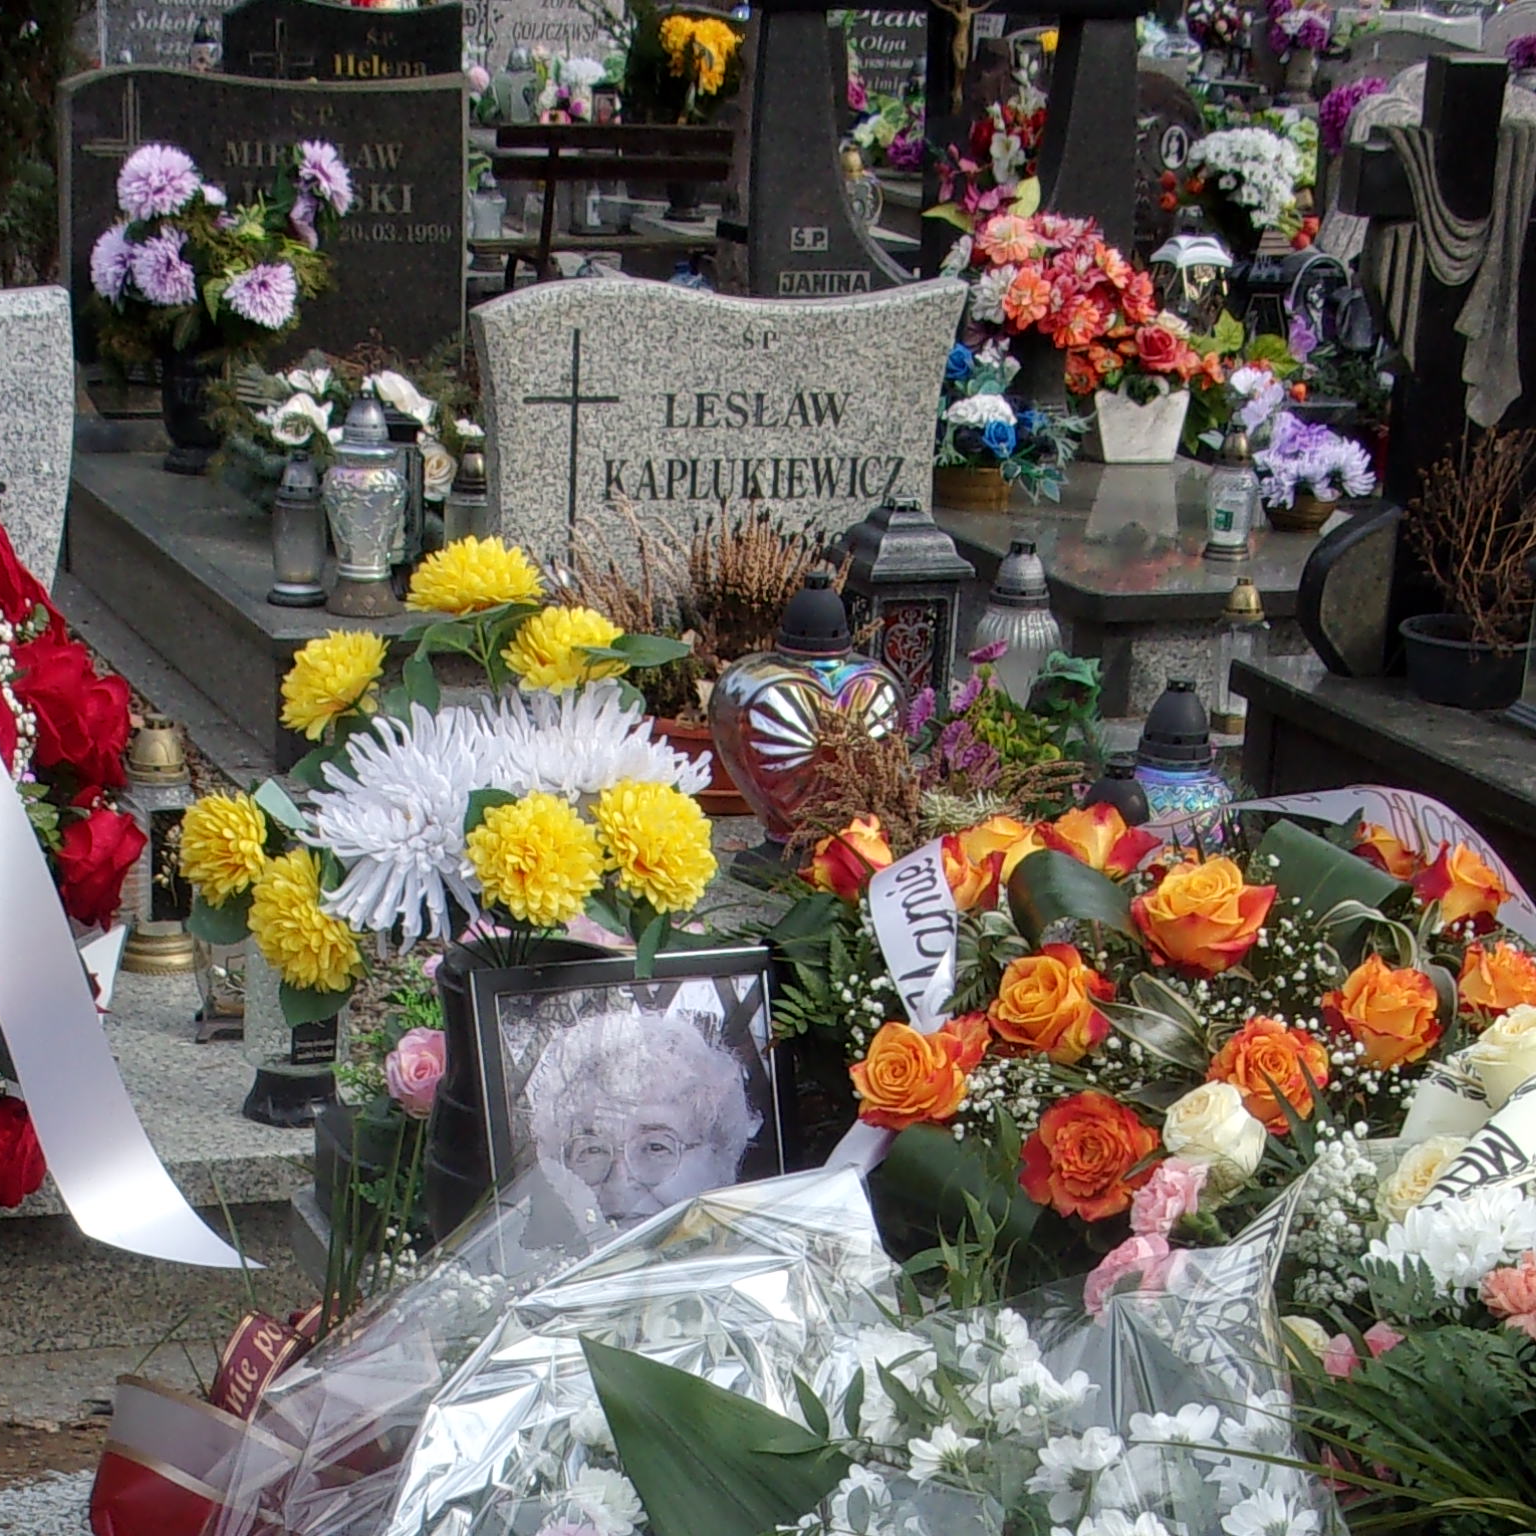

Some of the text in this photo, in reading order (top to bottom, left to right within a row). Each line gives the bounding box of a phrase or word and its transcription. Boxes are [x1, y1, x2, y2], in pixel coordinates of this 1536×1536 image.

[332, 53, 428, 78] Helena
[795, 230, 827, 248] Ś.P.
[782, 273, 868, 294] JANINA
[663, 391, 852, 430] LESŁAW
